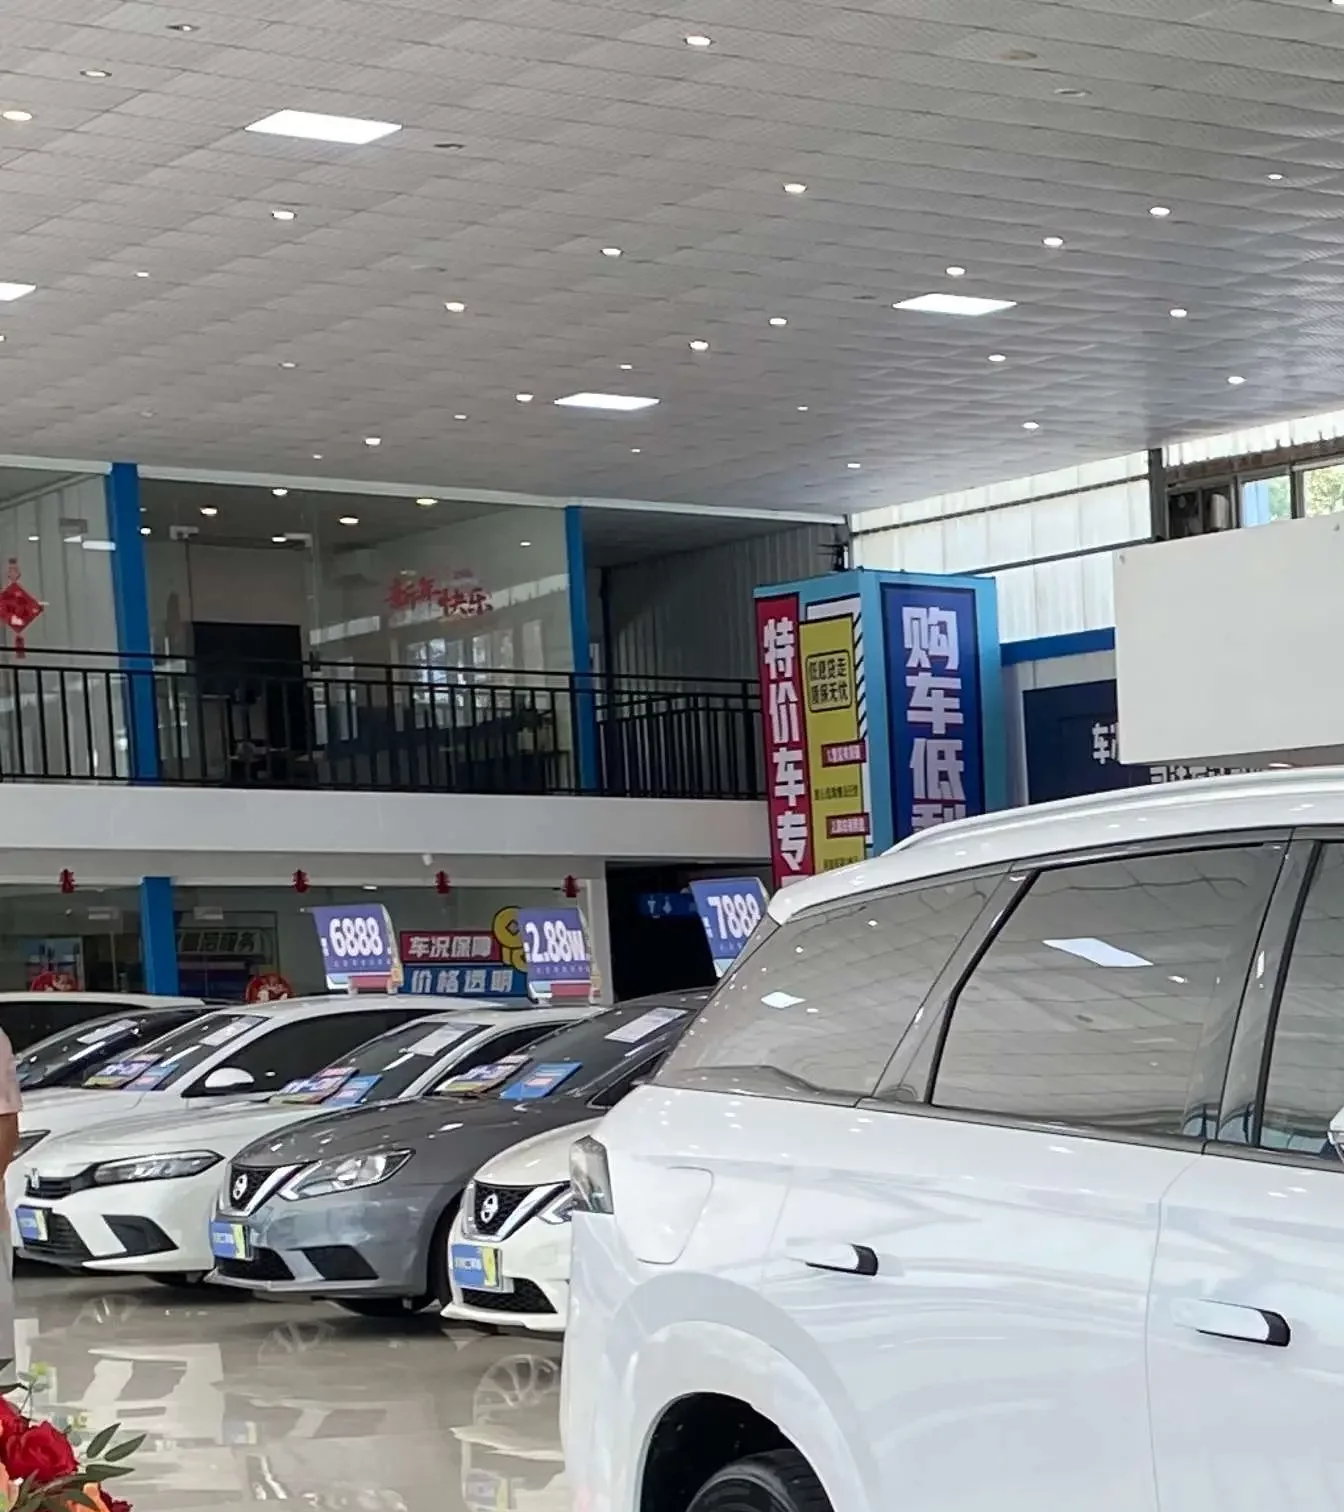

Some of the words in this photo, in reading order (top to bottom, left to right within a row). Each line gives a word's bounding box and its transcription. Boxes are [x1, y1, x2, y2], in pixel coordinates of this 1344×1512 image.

[762, 615, 814, 886] 特价车专
[329, 917, 383, 957] 6888
[409, 935, 493, 959] 车况保障
[411, 968, 513, 993] 价格透明
